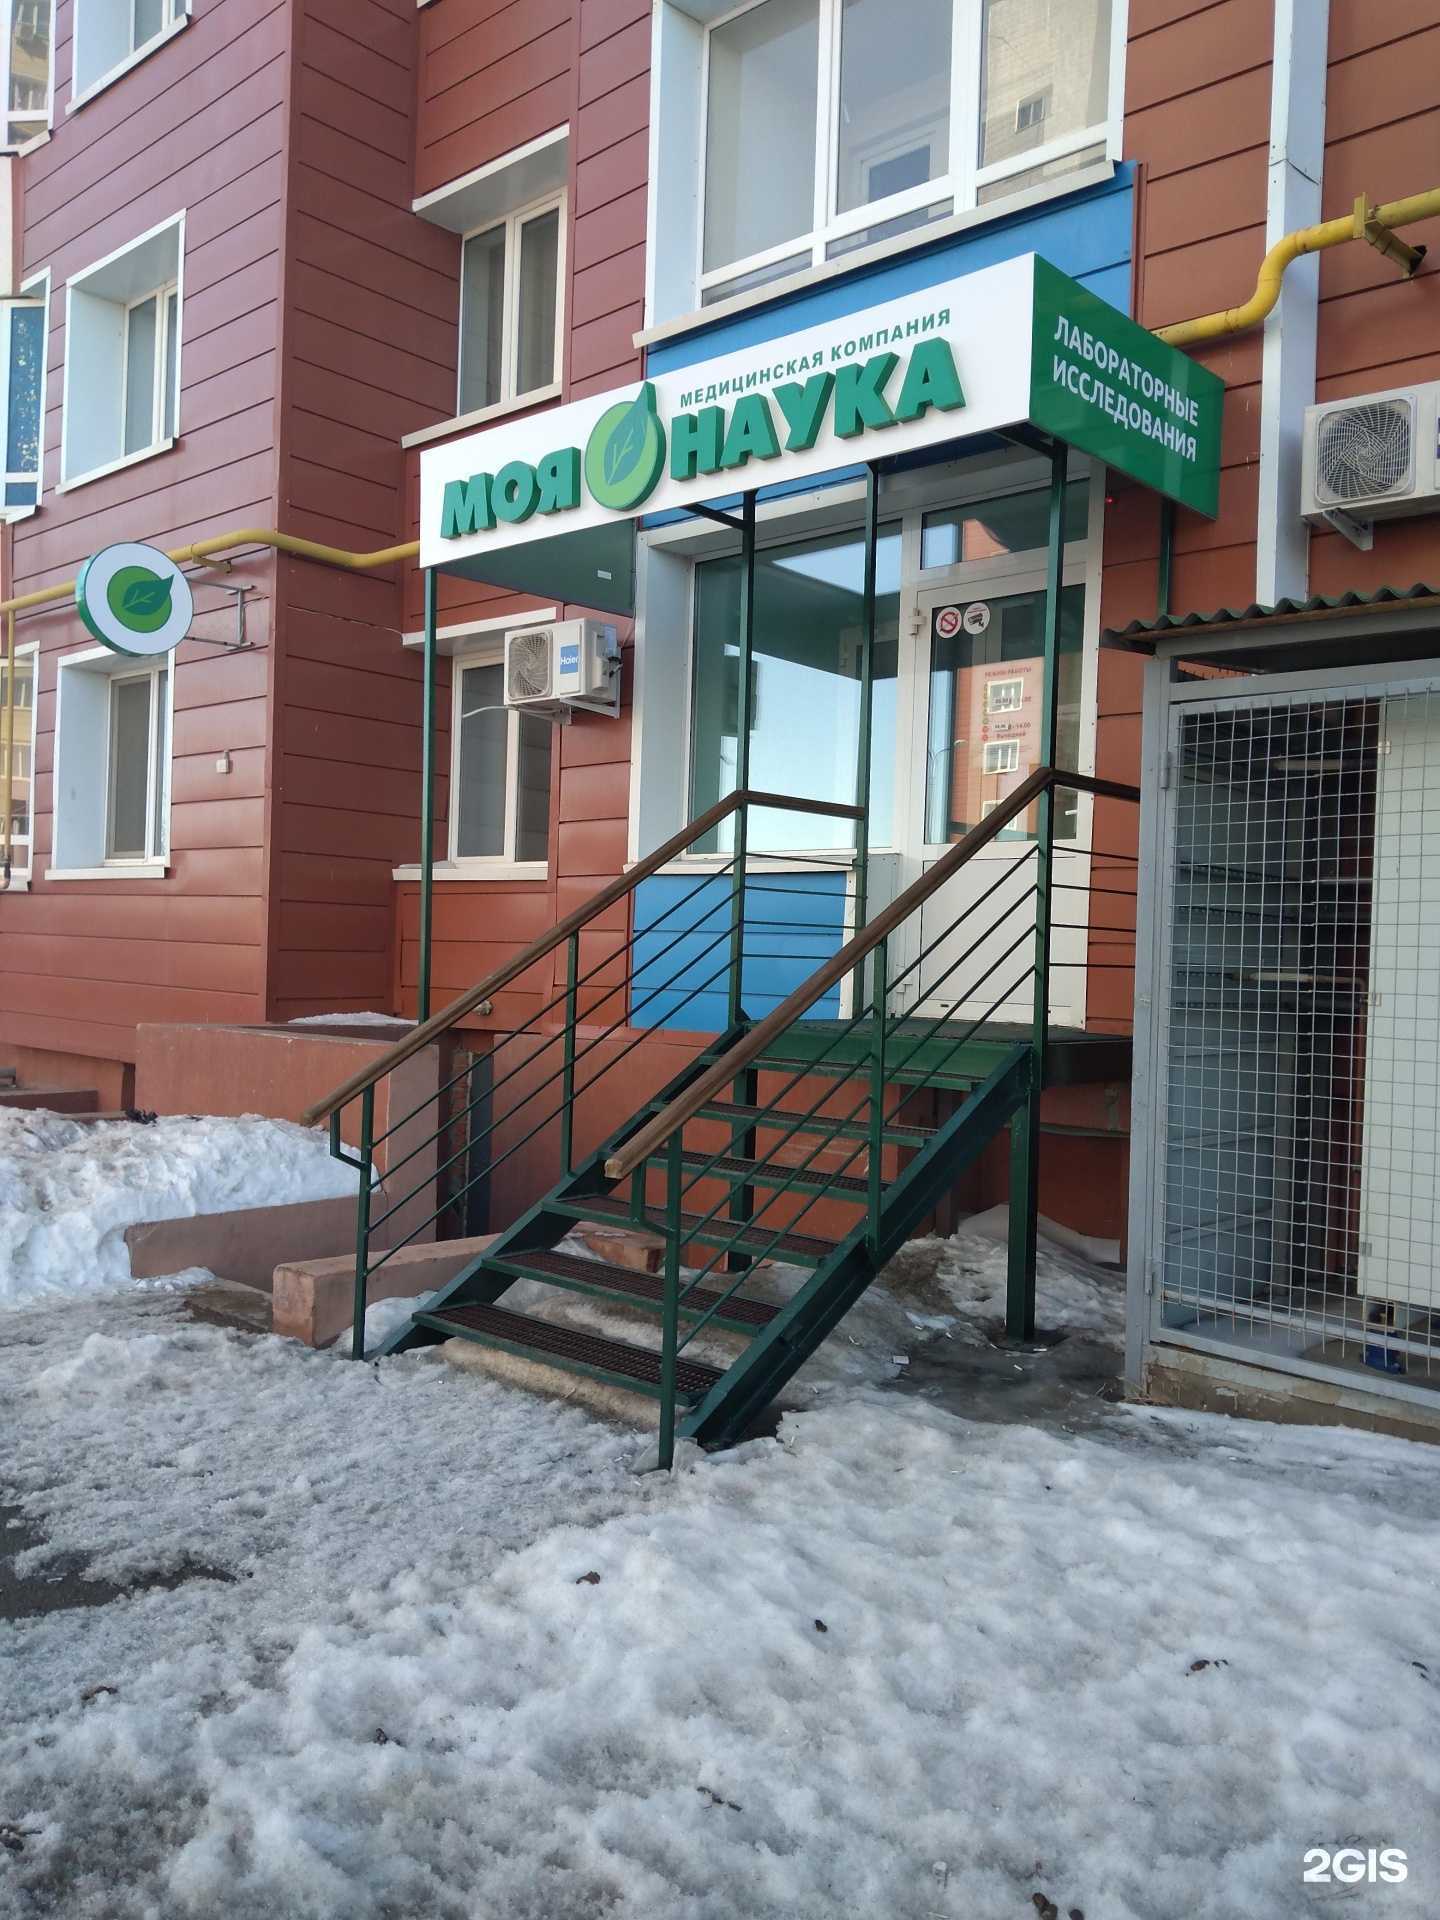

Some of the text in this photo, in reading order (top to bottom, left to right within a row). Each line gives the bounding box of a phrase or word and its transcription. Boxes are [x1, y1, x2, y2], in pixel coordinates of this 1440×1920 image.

[680, 308, 951, 408] МЕДИЦИНСКАЯ КОМПАНИЯ
[1053, 315, 1199, 427] ЛАБОРАТОРНЫЕ
[1053, 355, 1197, 462] ИССЛЕДОВАНИЯ
[440, 336, 966, 540] МОЯ НАУКА
[560, 655, 580, 665] Haier
